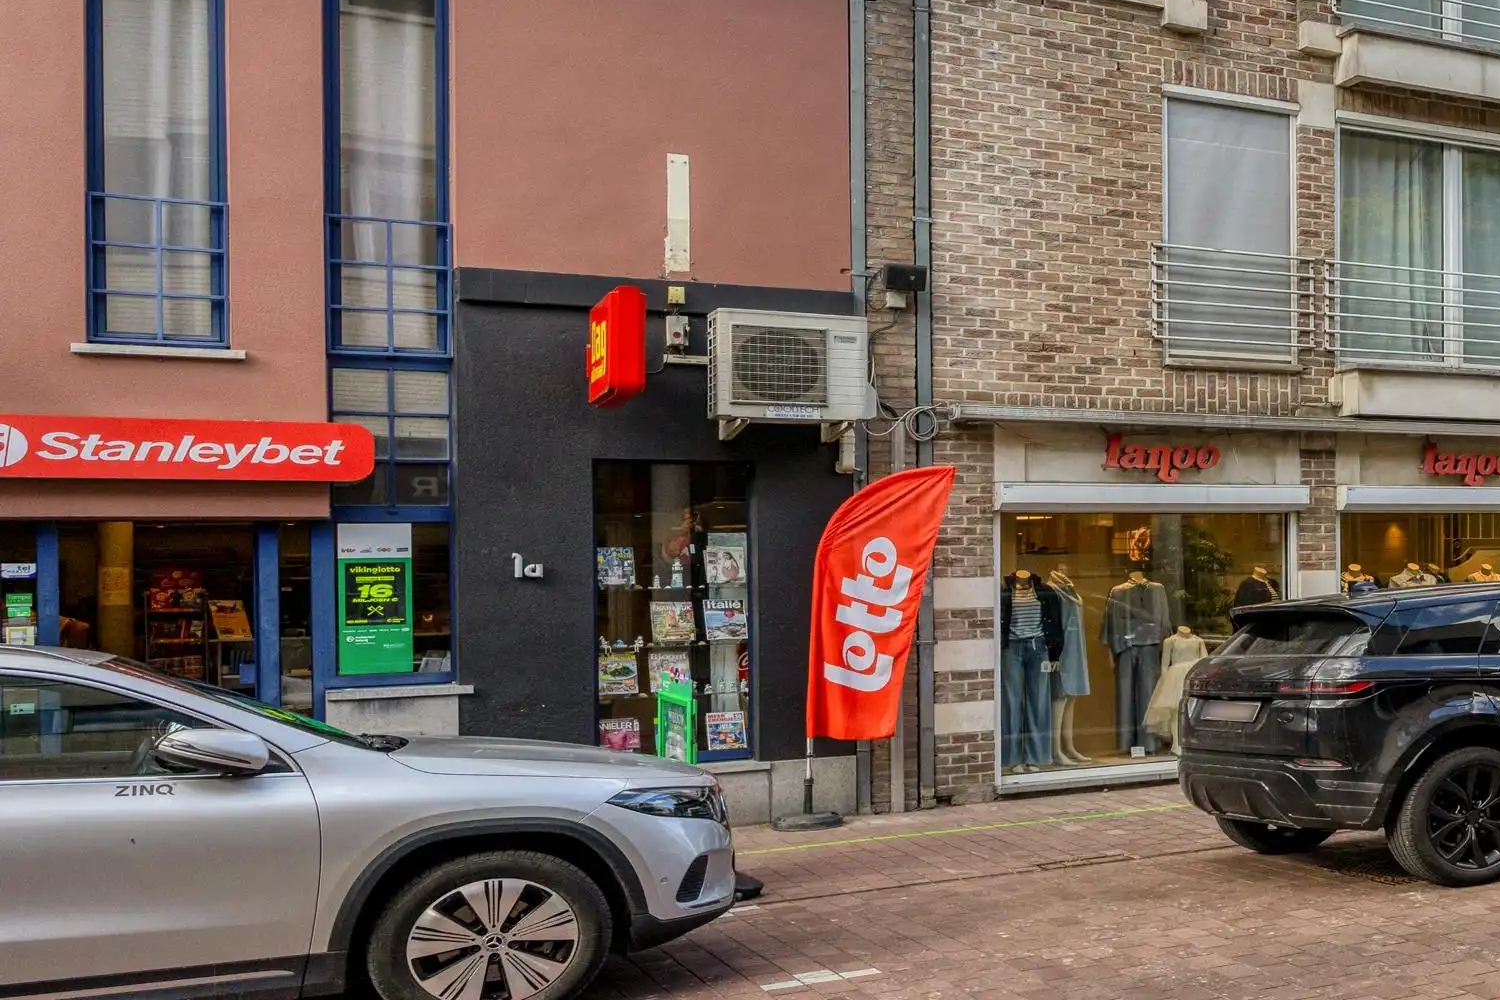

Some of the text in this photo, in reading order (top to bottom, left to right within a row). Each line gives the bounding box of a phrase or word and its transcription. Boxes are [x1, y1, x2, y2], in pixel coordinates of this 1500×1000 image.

[36, 431, 344, 469] Stanleybet
[349, 566, 401, 574] vikinglotto
[358, 584, 394, 598] 16
[114, 784, 175, 797] ZINQ
